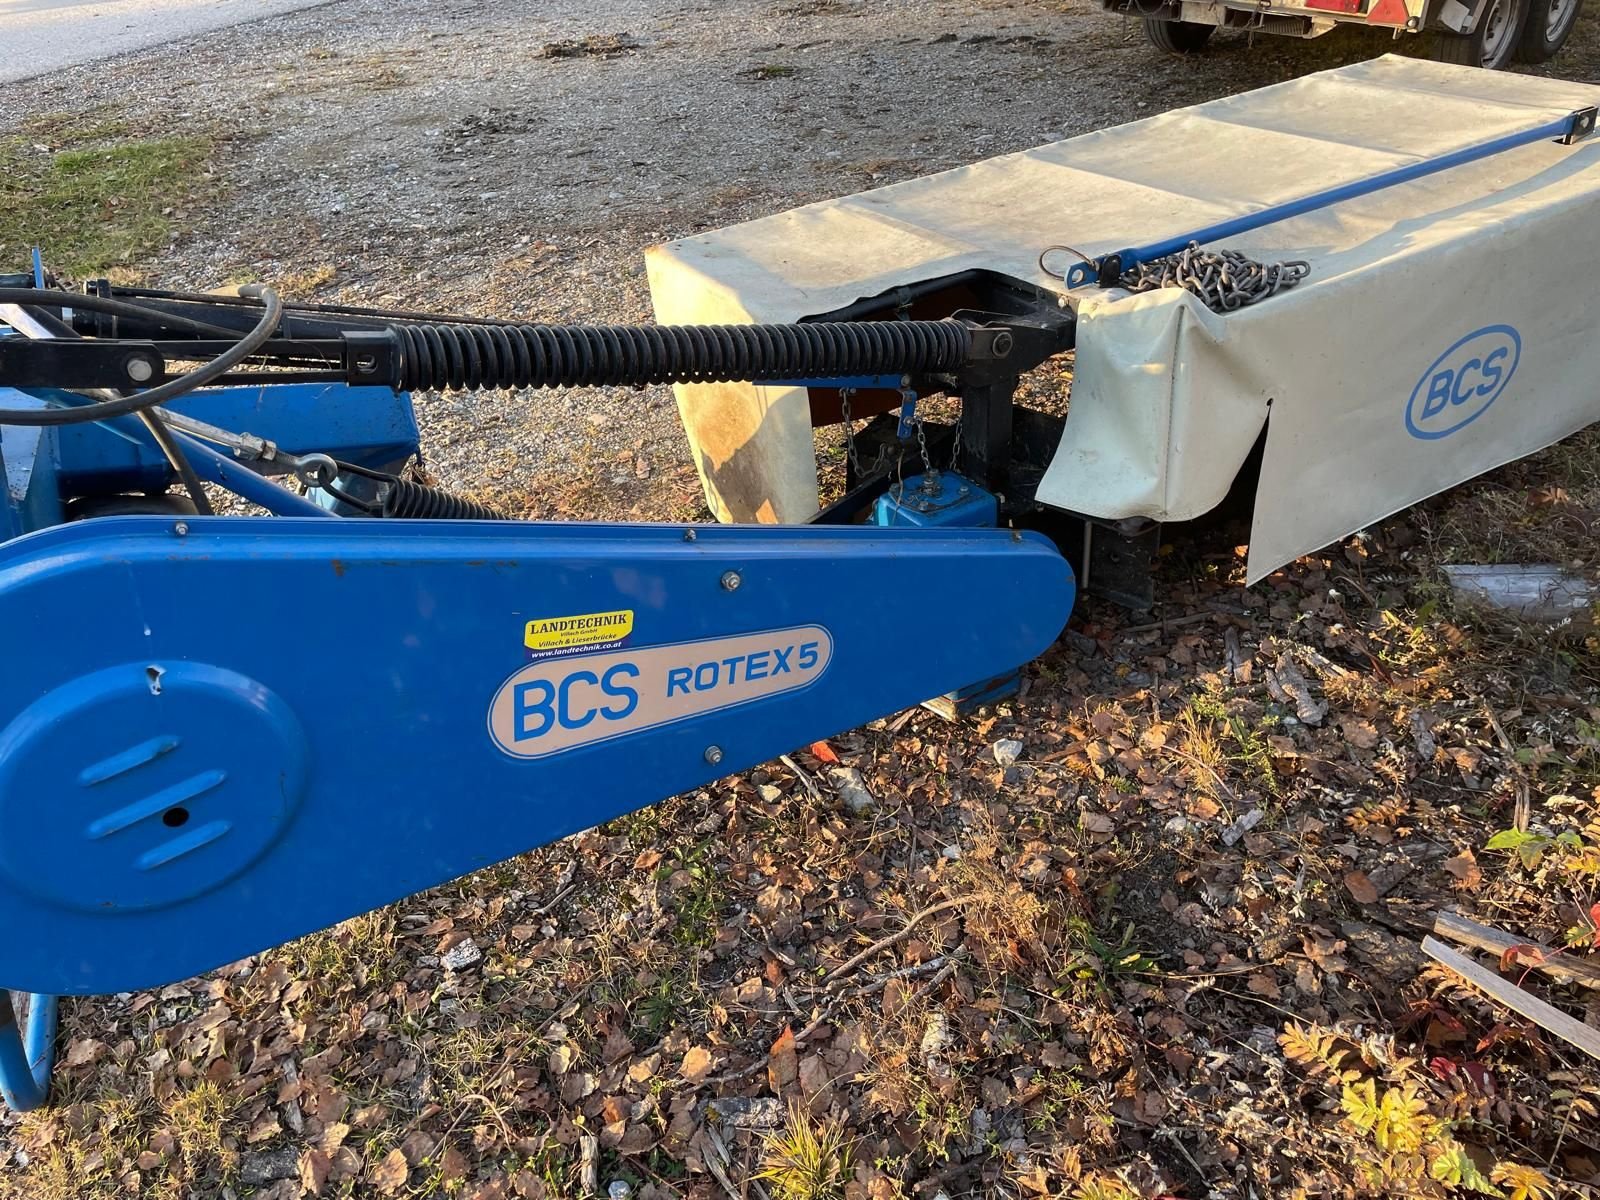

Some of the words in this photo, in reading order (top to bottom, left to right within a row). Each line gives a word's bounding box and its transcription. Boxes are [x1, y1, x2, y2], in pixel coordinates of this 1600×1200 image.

[1421, 347, 1508, 420] BCS
[530, 614, 627, 634] LANDTECHNIK
[531, 641, 622, 658] www.landtechnik.co.at
[538, 639, 563, 648] Villach
[572, 633, 617, 644] Lieserbrücke
[513, 662, 641, 742] BCS
